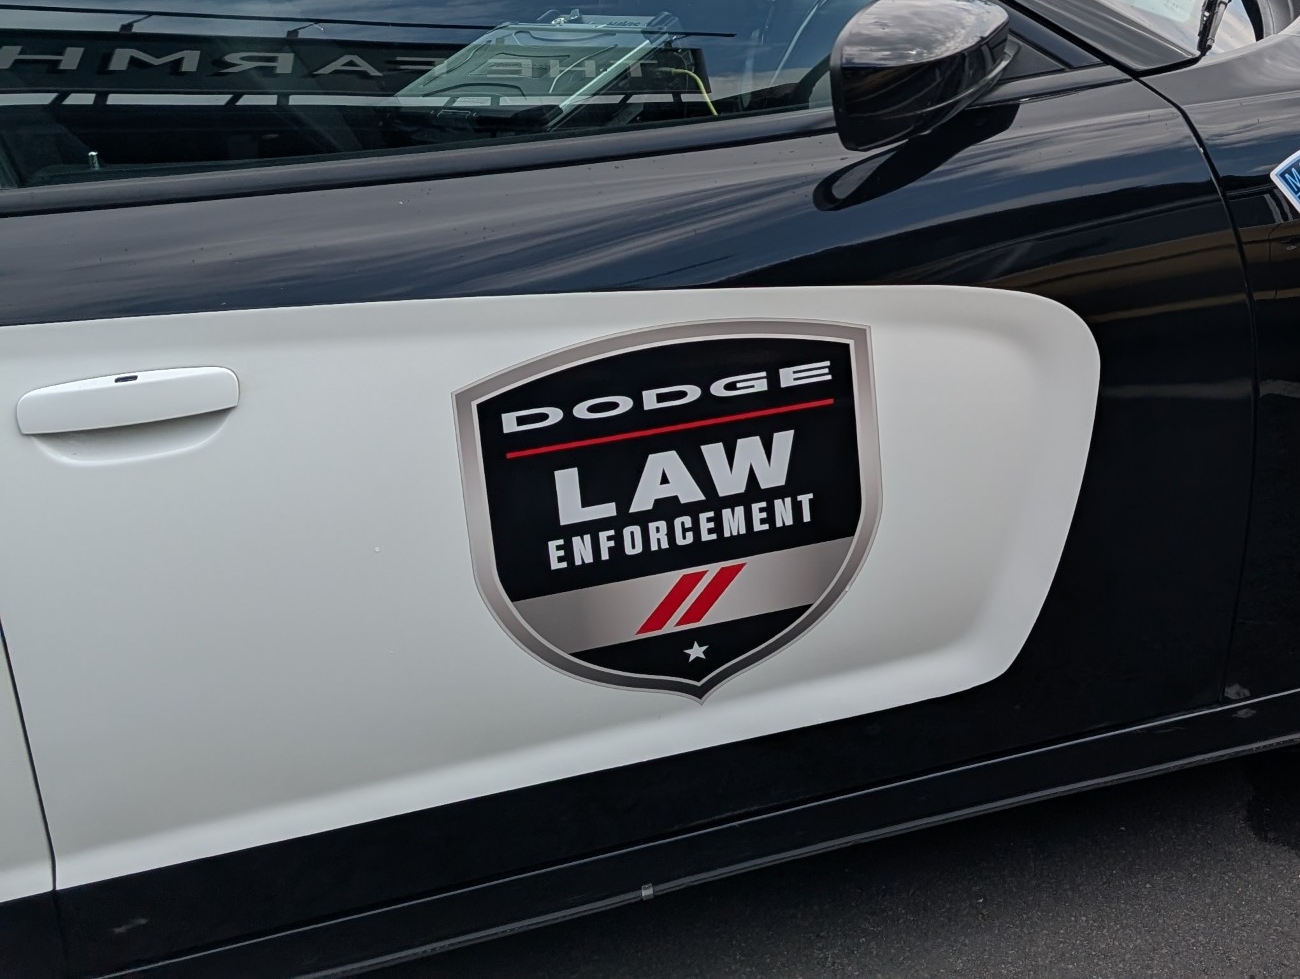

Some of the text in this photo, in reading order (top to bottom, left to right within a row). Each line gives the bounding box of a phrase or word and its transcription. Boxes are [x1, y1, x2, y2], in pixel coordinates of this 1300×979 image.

[501, 359, 832, 434] DODGE
[554, 429, 795, 527] LAW
[547, 492, 814, 571] ENFORCEMENT
